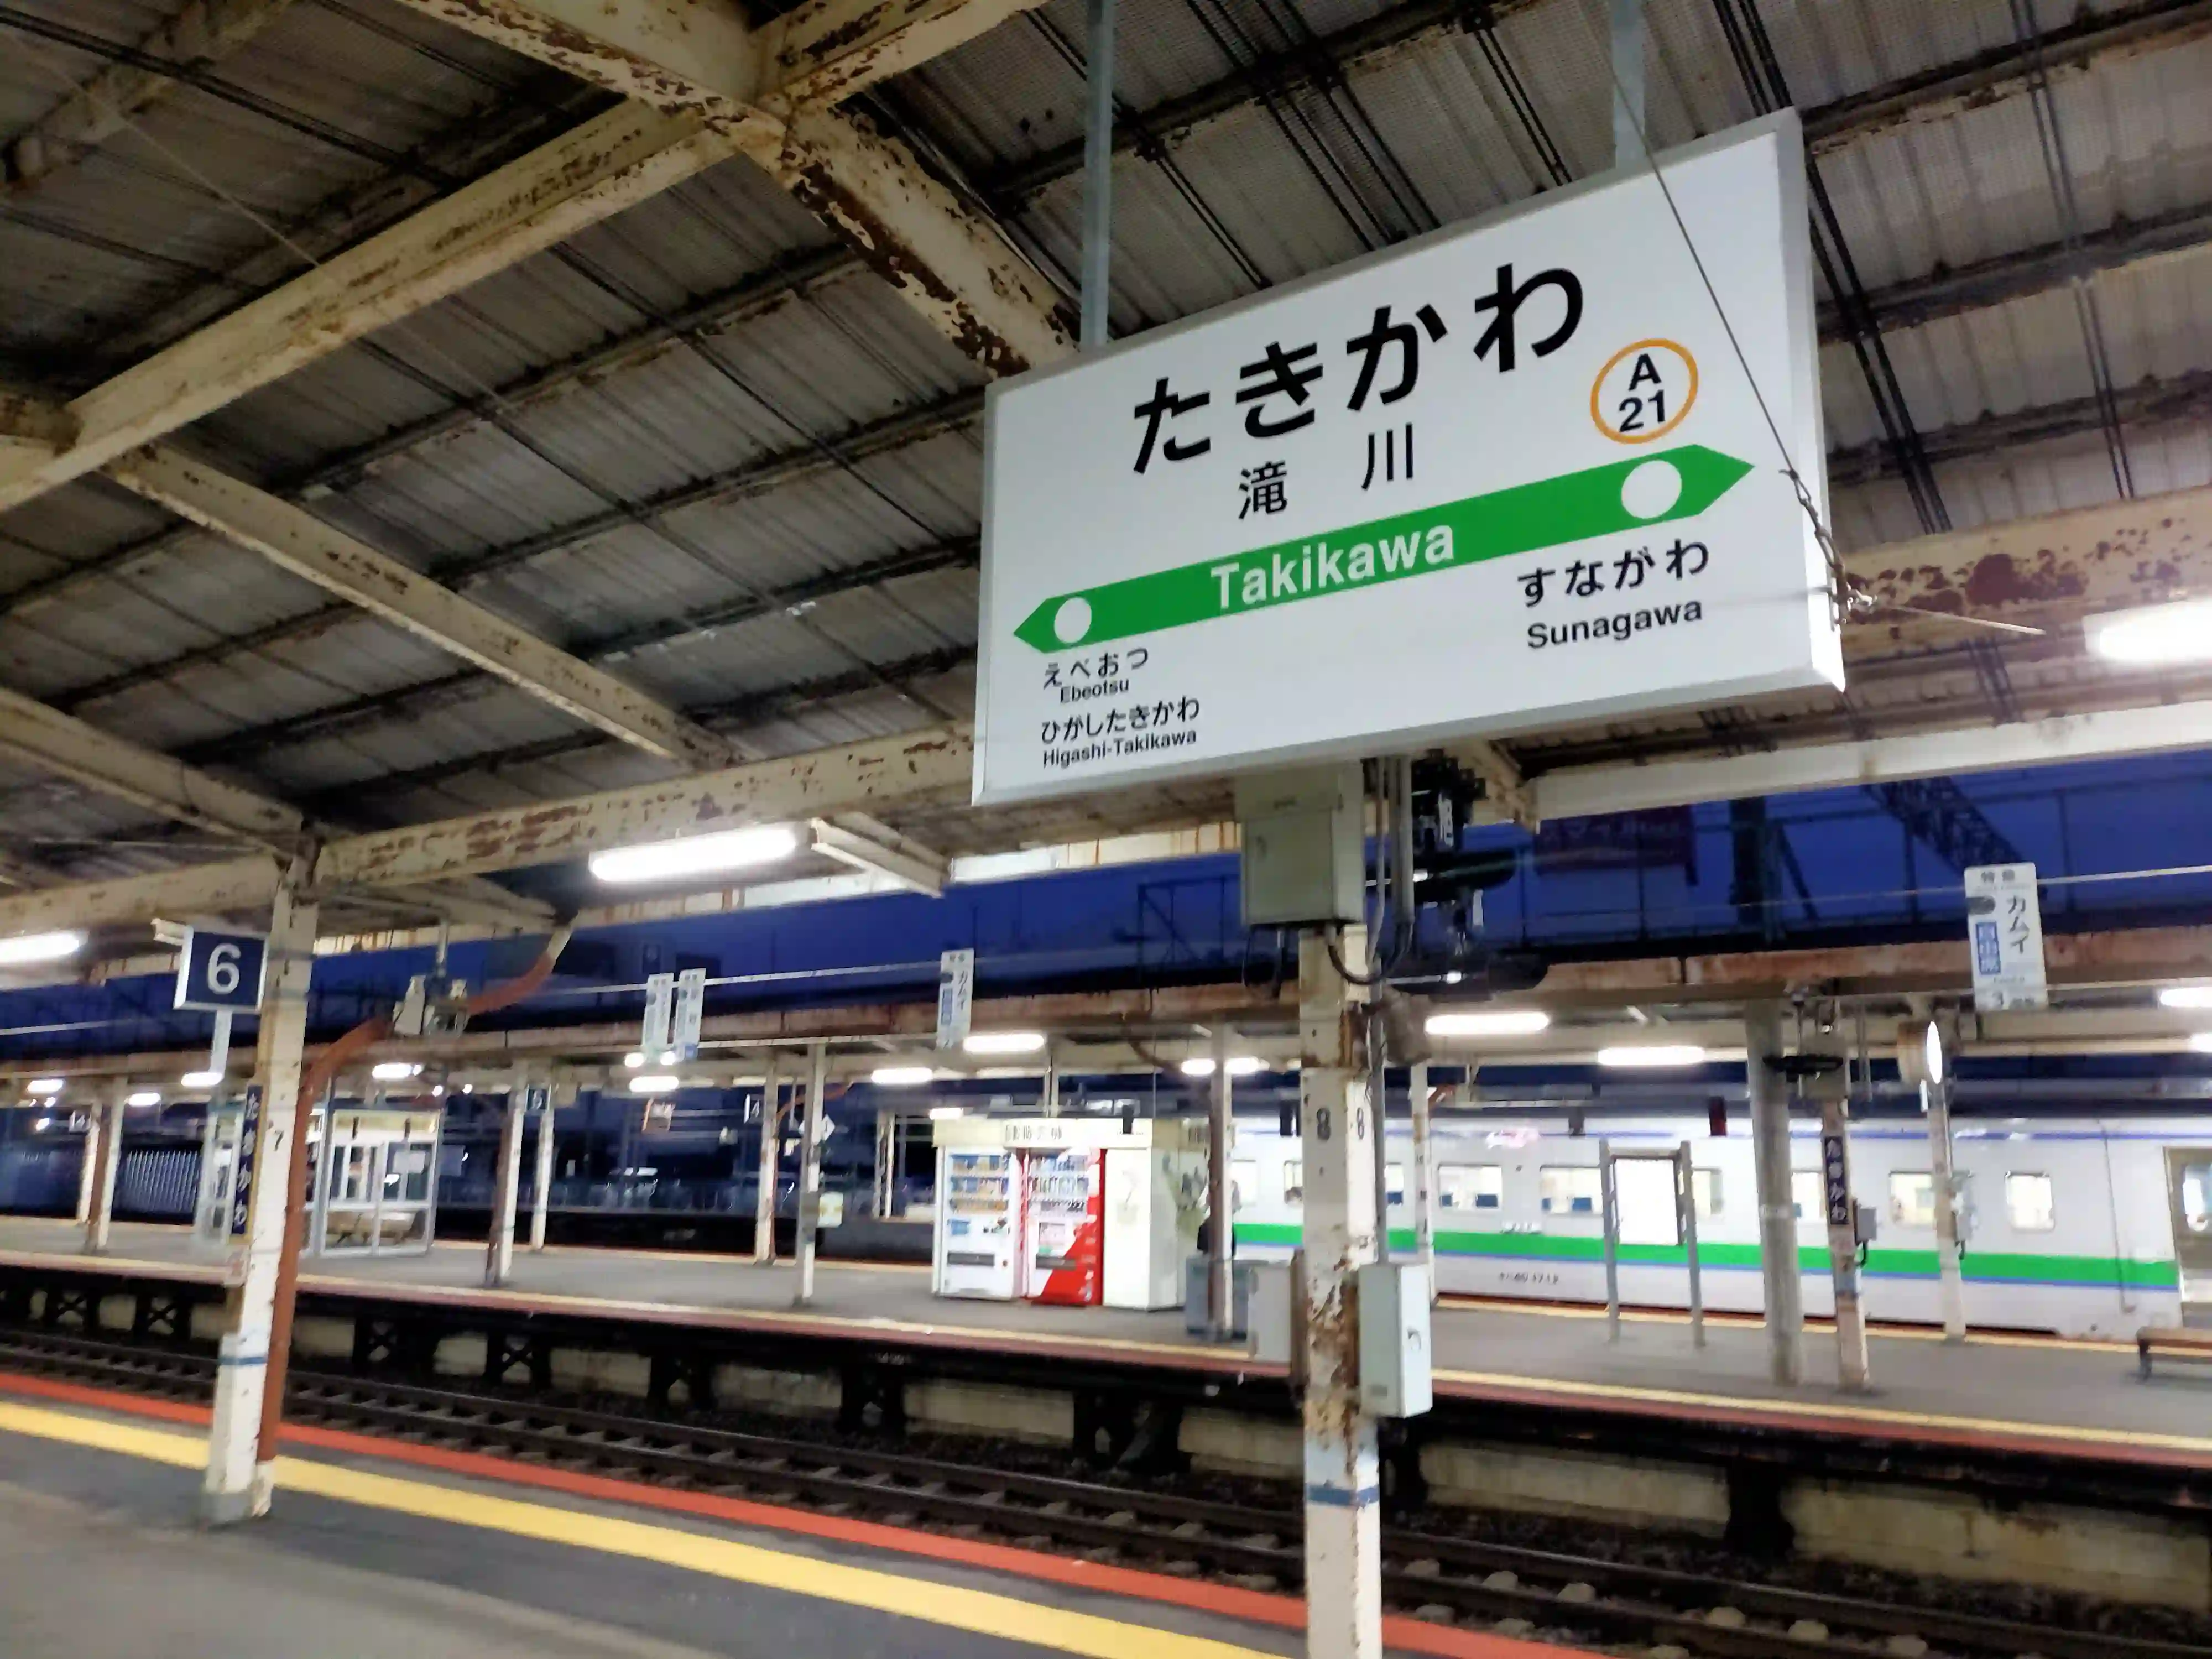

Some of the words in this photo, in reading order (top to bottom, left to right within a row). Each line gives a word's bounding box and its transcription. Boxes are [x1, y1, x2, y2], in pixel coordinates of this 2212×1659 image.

[1133, 262, 1584, 475] たきかわ
[1628, 353, 1662, 390] A
[1619, 389, 1666, 433] 21
[1238, 422, 1414, 520] 滝川
[1211, 524, 1454, 609] Takikawa
[1517, 538, 1709, 608] すながわ
[1527, 600, 1702, 649] Sunagawa
[1043, 647, 1149, 690] えべおつ
[1060, 679, 1130, 703] Ebeotsu
[1042, 695, 1200, 745] ひがしたきかわ
[1043, 729, 1197, 769] Higashi-Takikawa
[207, 942, 242, 995] 6
[1316, 1108, 1332, 1141] 8
[1357, 1107, 1365, 1140] 8
